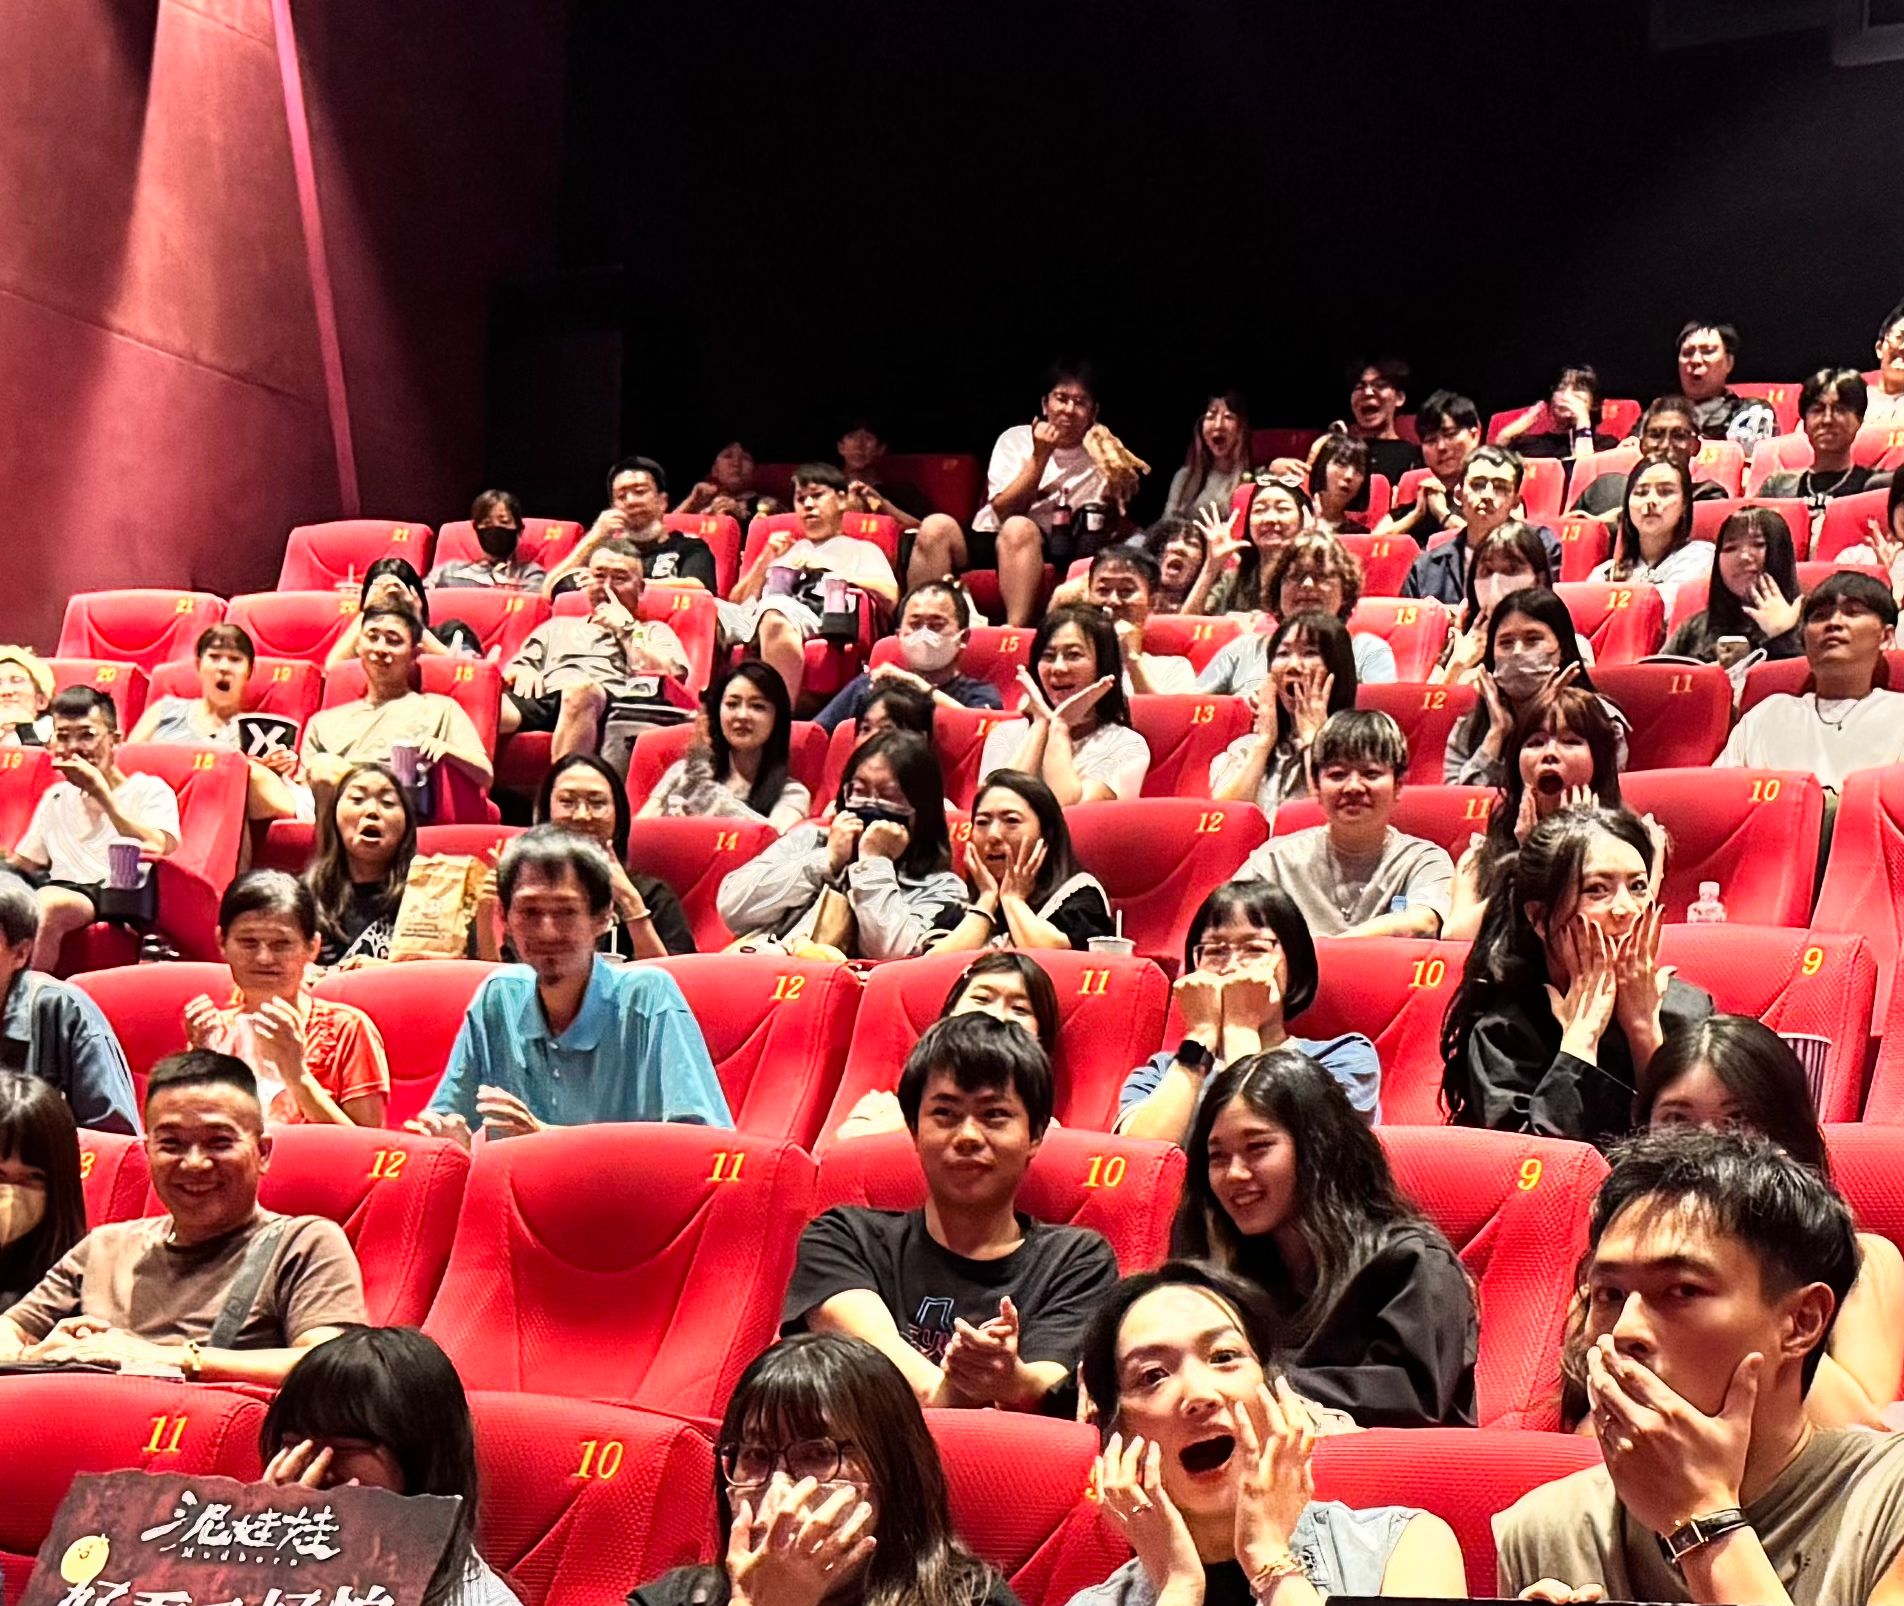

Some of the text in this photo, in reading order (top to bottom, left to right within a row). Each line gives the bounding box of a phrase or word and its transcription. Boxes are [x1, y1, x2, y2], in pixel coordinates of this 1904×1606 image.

[392, 528, 409, 542] 21
[176, 596, 196, 614] 21
[1608, 587, 1633, 610] 12
[1001, 636, 1018, 651] 15
[98, 665, 118, 682] 20
[273, 666, 292, 682] 19
[1670, 676, 1693, 694] 11
[1424, 691, 1446, 711] 12
[1193, 703, 1215, 723] 13
[3, 748, 23, 768] 19
[195, 753, 215, 770] 18
[1752, 776, 1782, 801] 10
[1464, 799, 1491, 820] 11
[950, 821, 973, 841] 13
[1199, 812, 1225, 833] 12
[718, 832, 739, 850] 14
[1803, 948, 1823, 975] 9
[1082, 970, 1109, 995] 11
[1411, 960, 1444, 989] 10
[774, 976, 806, 1000] 12
[370, 1151, 407, 1181] 12
[712, 1152, 744, 1182] 11
[1087, 1157, 1126, 1187] 10
[1520, 1160, 1542, 1191] 9
[148, 1418, 186, 1452] 11
[578, 1442, 623, 1479] 10
[140, 1490, 342, 1560] 泥娃娃
